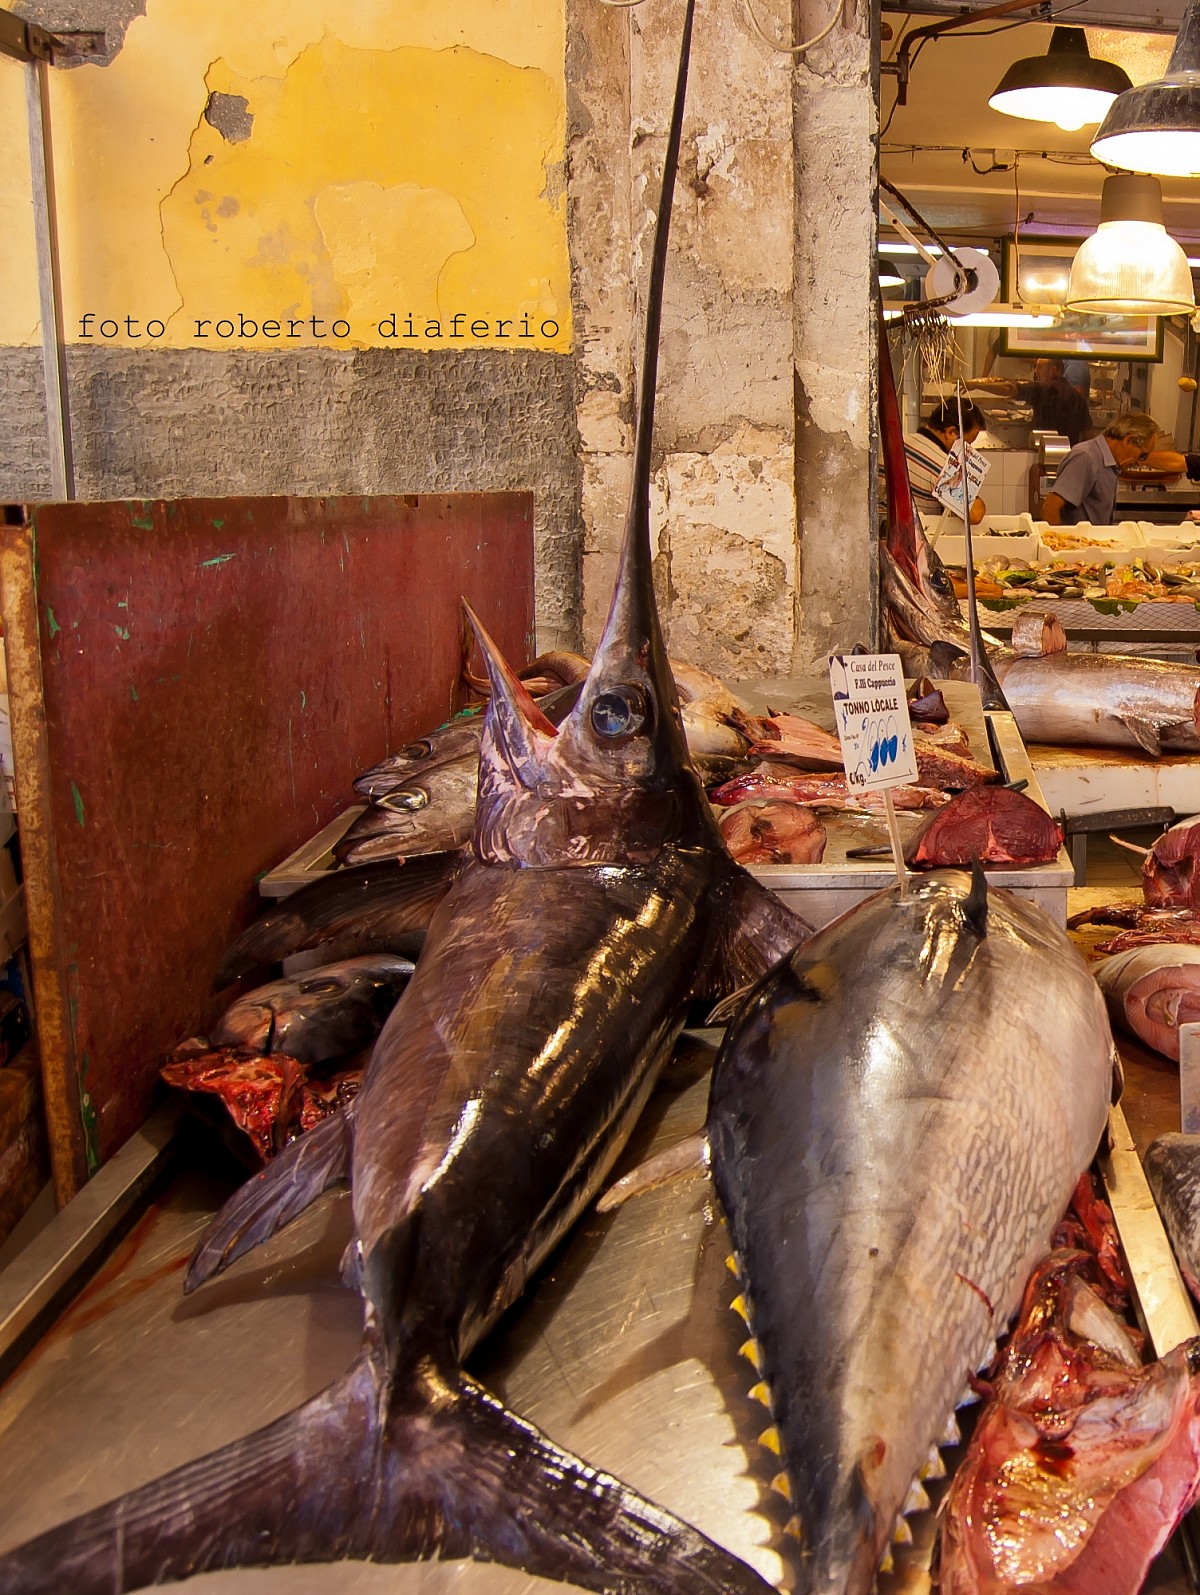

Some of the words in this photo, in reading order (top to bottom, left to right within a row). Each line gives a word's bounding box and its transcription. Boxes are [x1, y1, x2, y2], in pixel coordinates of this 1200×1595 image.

[850, 661, 866, 673] Casa
[867, 659, 877, 672] del
[878, 659, 895, 671] Pesce
[867, 676, 896, 690] Cappuccio
[843, 700, 870, 716] TONNO
